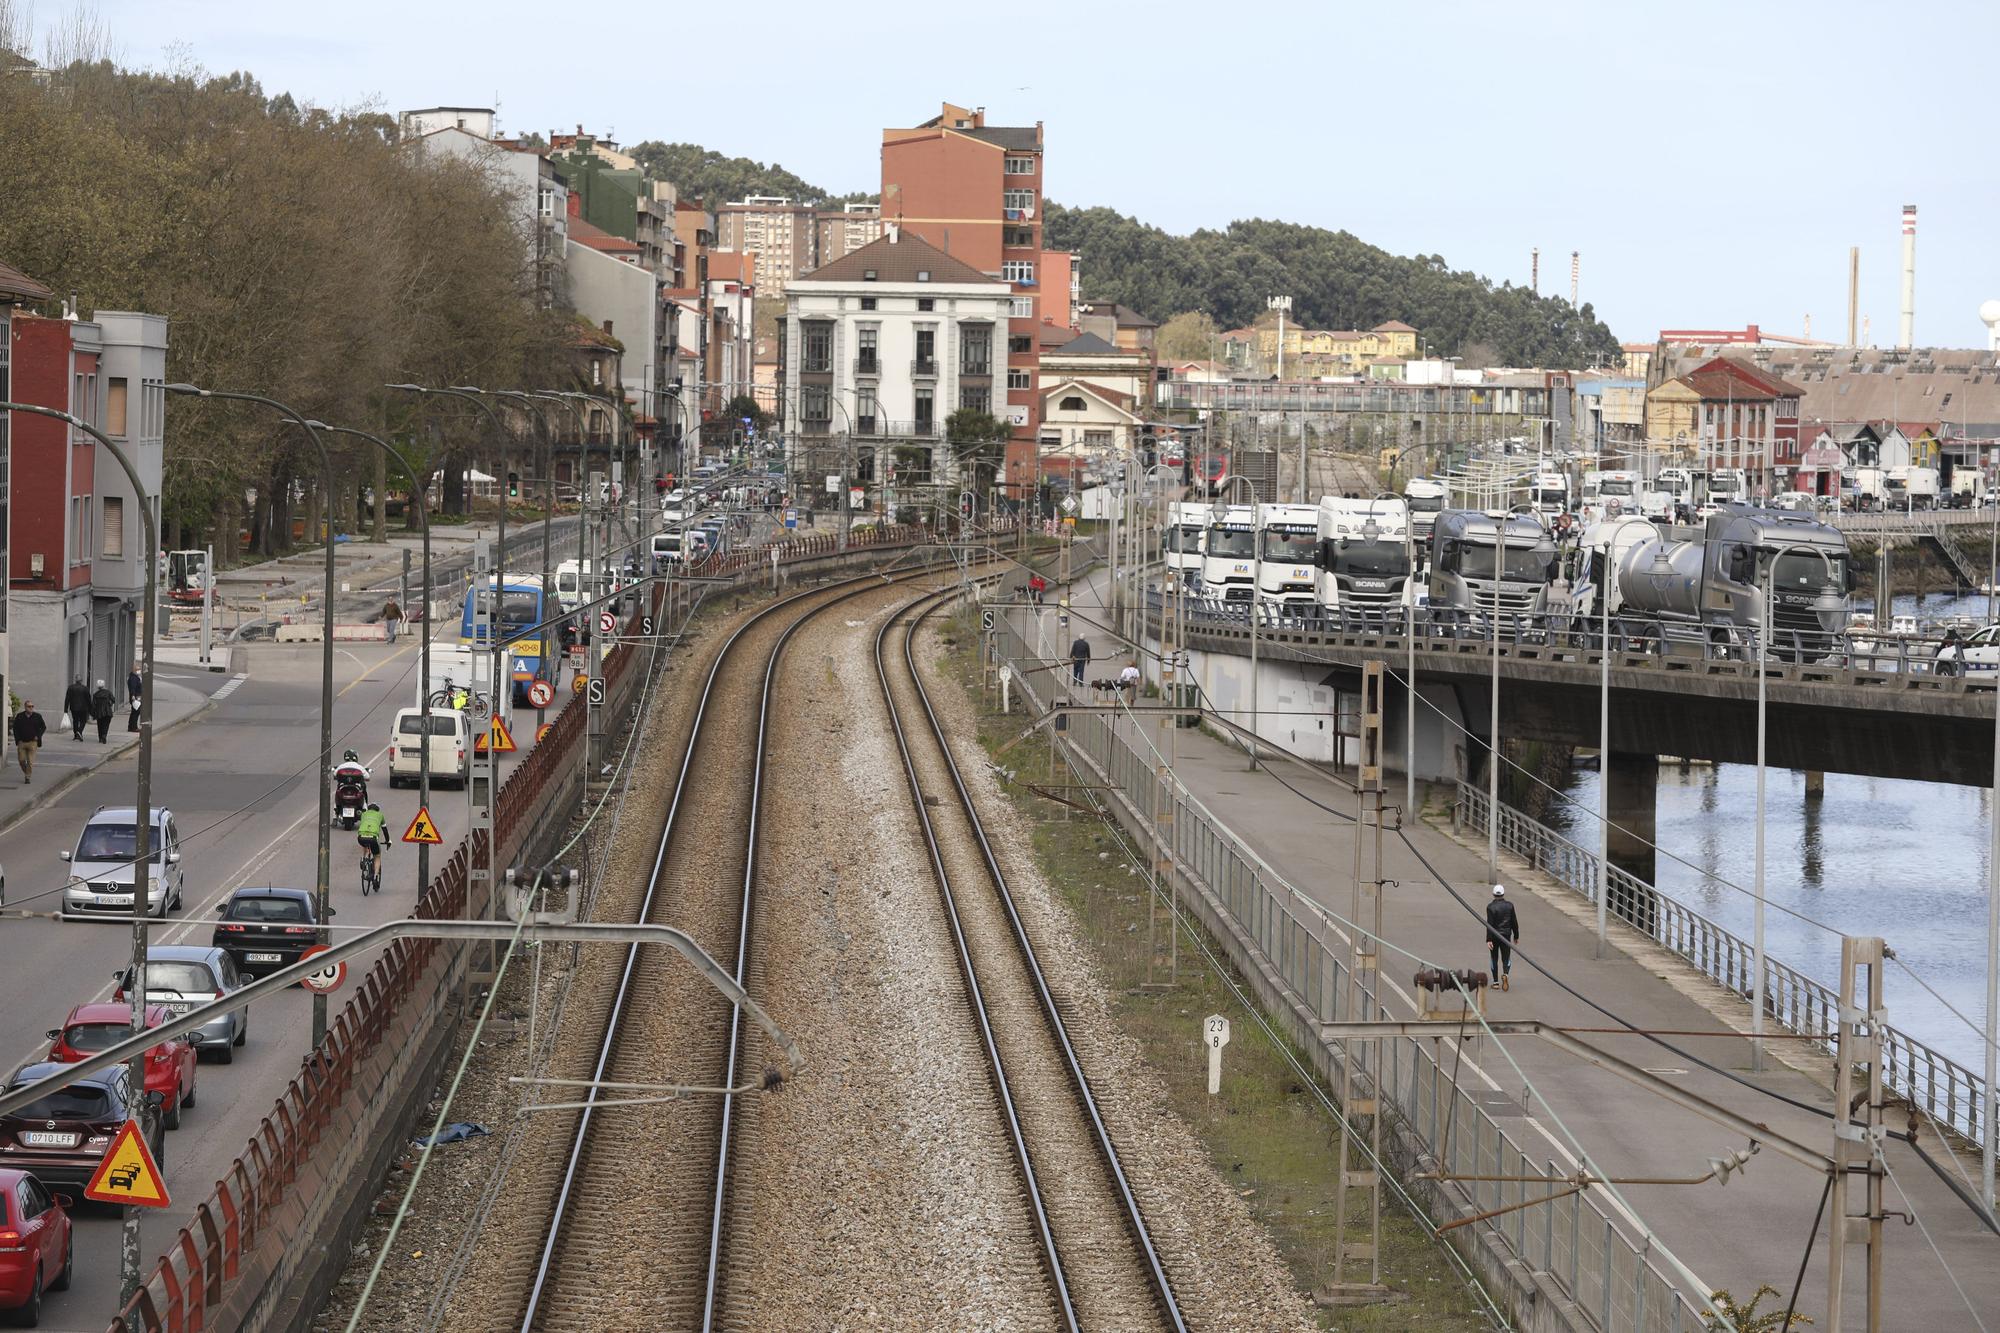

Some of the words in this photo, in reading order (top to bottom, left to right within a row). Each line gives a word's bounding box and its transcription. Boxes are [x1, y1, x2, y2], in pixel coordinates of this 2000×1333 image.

[1234, 564, 1248, 572] LTA
[1293, 568, 1308, 577] LTA
[984, 611, 993, 628] S
[643, 617, 651, 635] S
[590, 680, 602, 702] S
[1210, 1020, 1223, 1032] 23
[1213, 1036, 1219, 1048] 8
[32, 1133, 55, 1143] 0710
[56, 1134, 73, 1143] LFF
